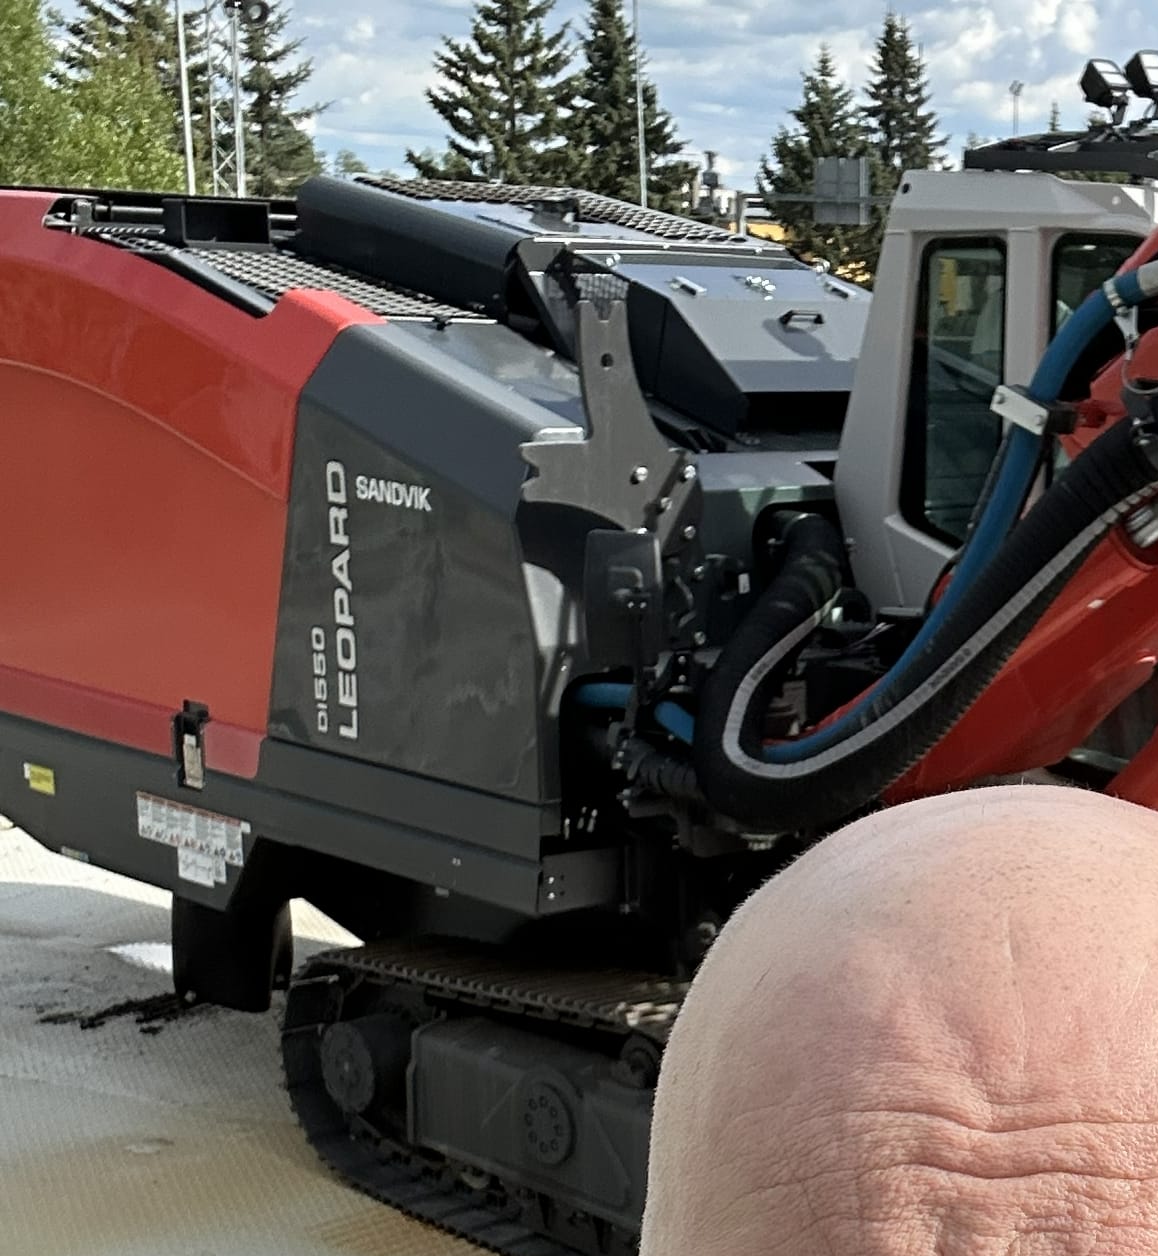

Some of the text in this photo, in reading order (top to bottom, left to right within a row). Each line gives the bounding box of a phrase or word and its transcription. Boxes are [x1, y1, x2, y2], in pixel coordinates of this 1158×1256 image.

[355, 475, 432, 512] SANDVIK
[326, 459, 359, 740] LEOPARD
[311, 626, 328, 733] DI550
